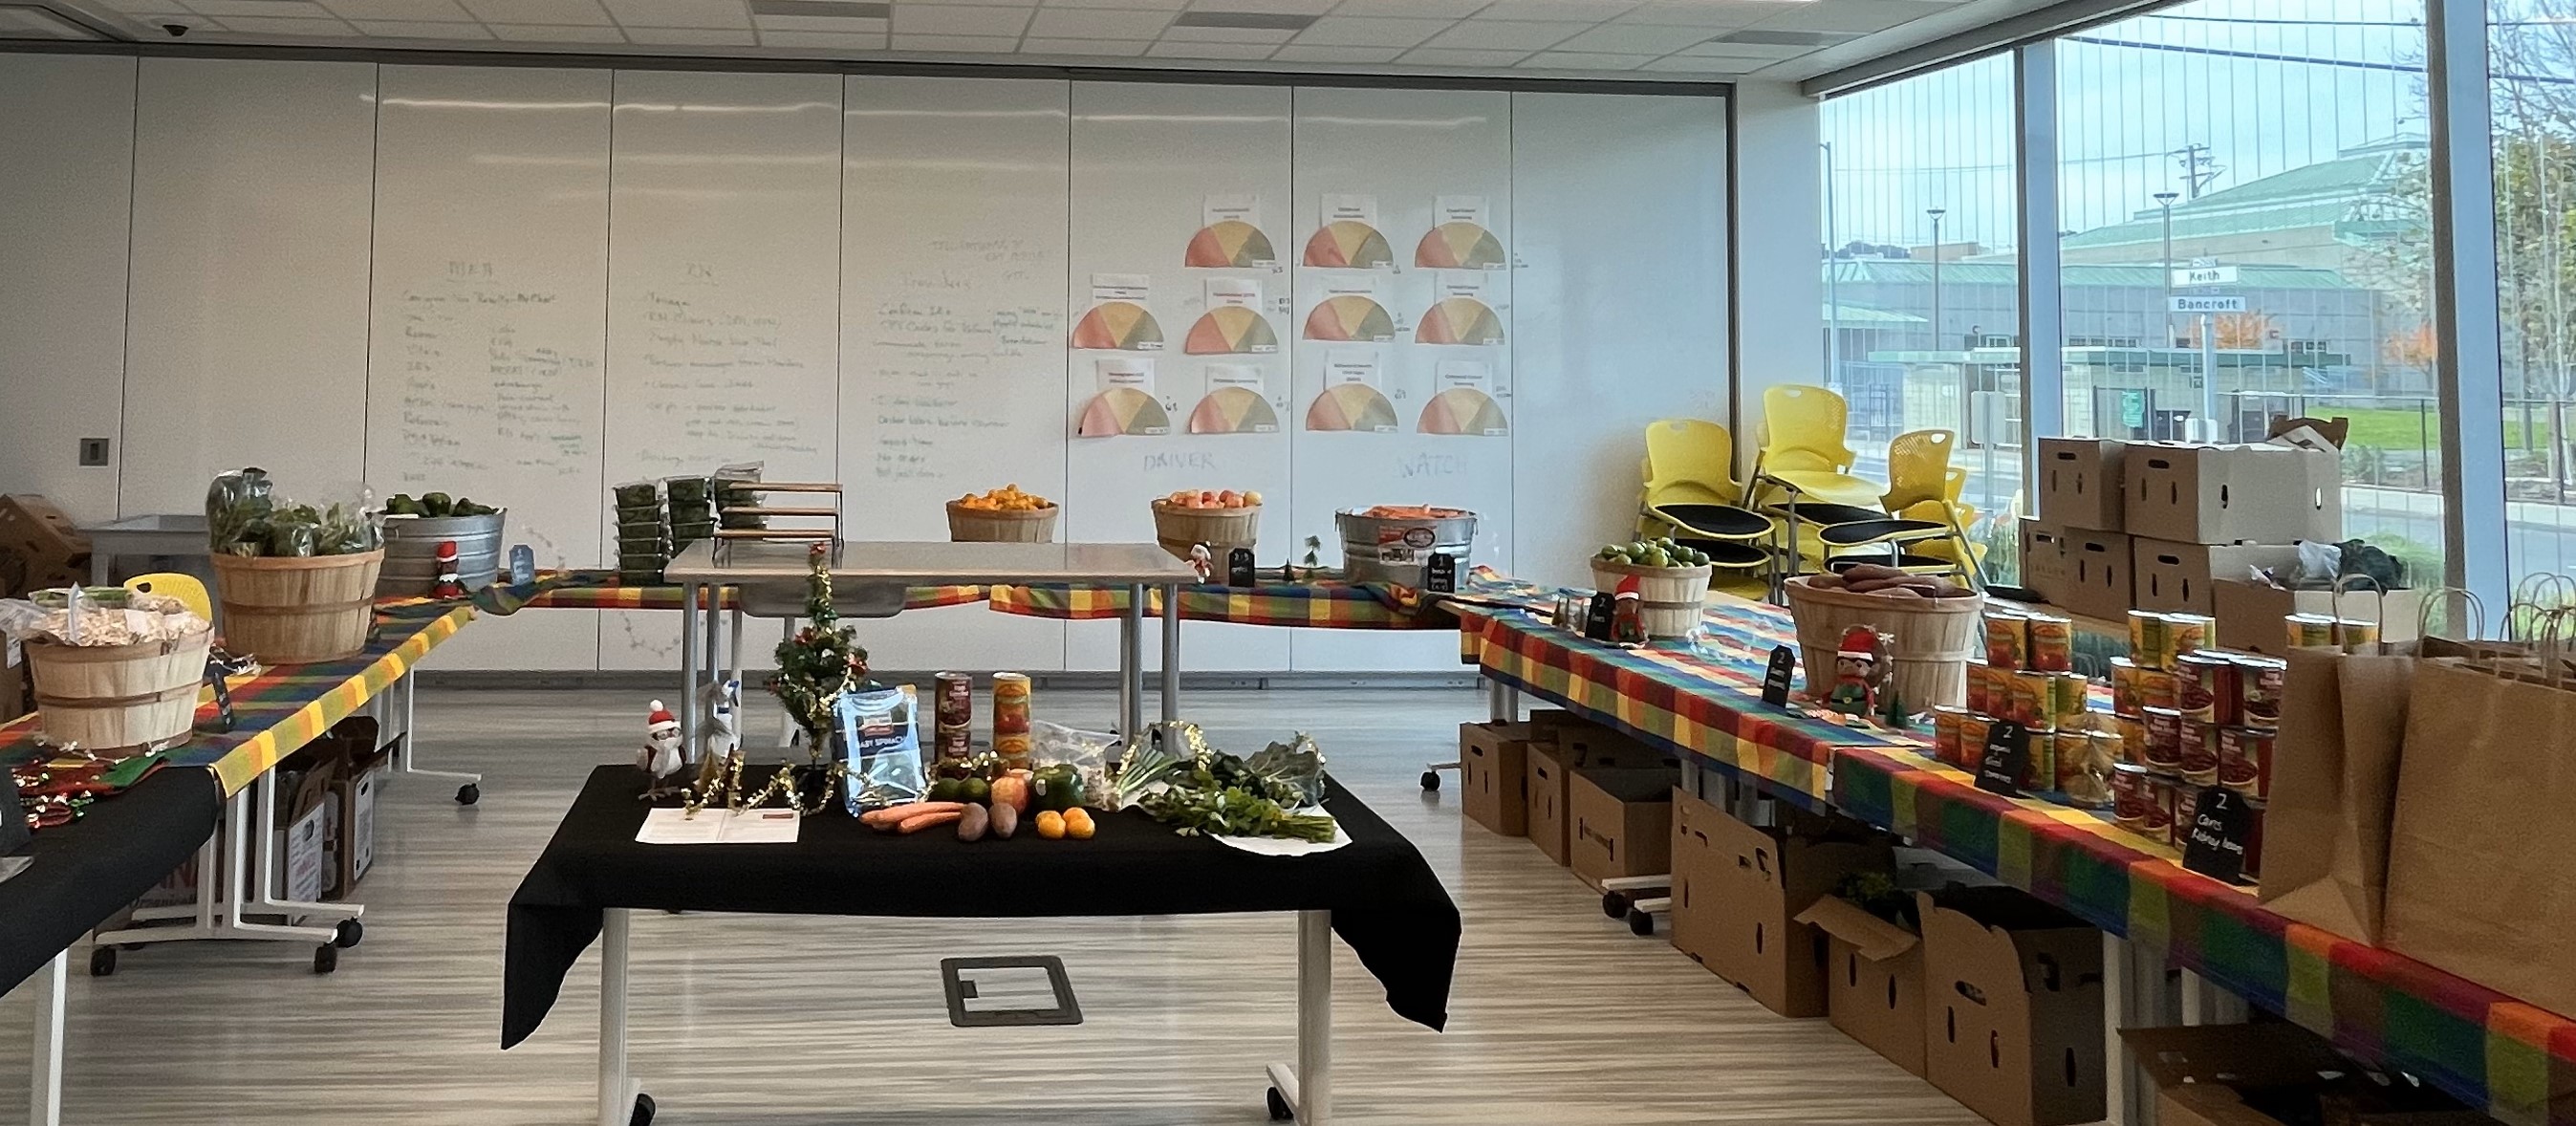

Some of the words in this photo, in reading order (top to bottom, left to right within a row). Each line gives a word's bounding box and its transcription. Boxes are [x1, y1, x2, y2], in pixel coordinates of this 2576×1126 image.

[2189, 270, 2220, 282] Keith
[2177, 298, 2239, 310] Bancroft
[1143, 452, 1218, 472] DRIVER
[1777, 651, 1786, 664] 2
[2002, 725, 2014, 739] 2
[875, 735, 904, 747] SPINAC
[2216, 792, 2228, 811] 2
